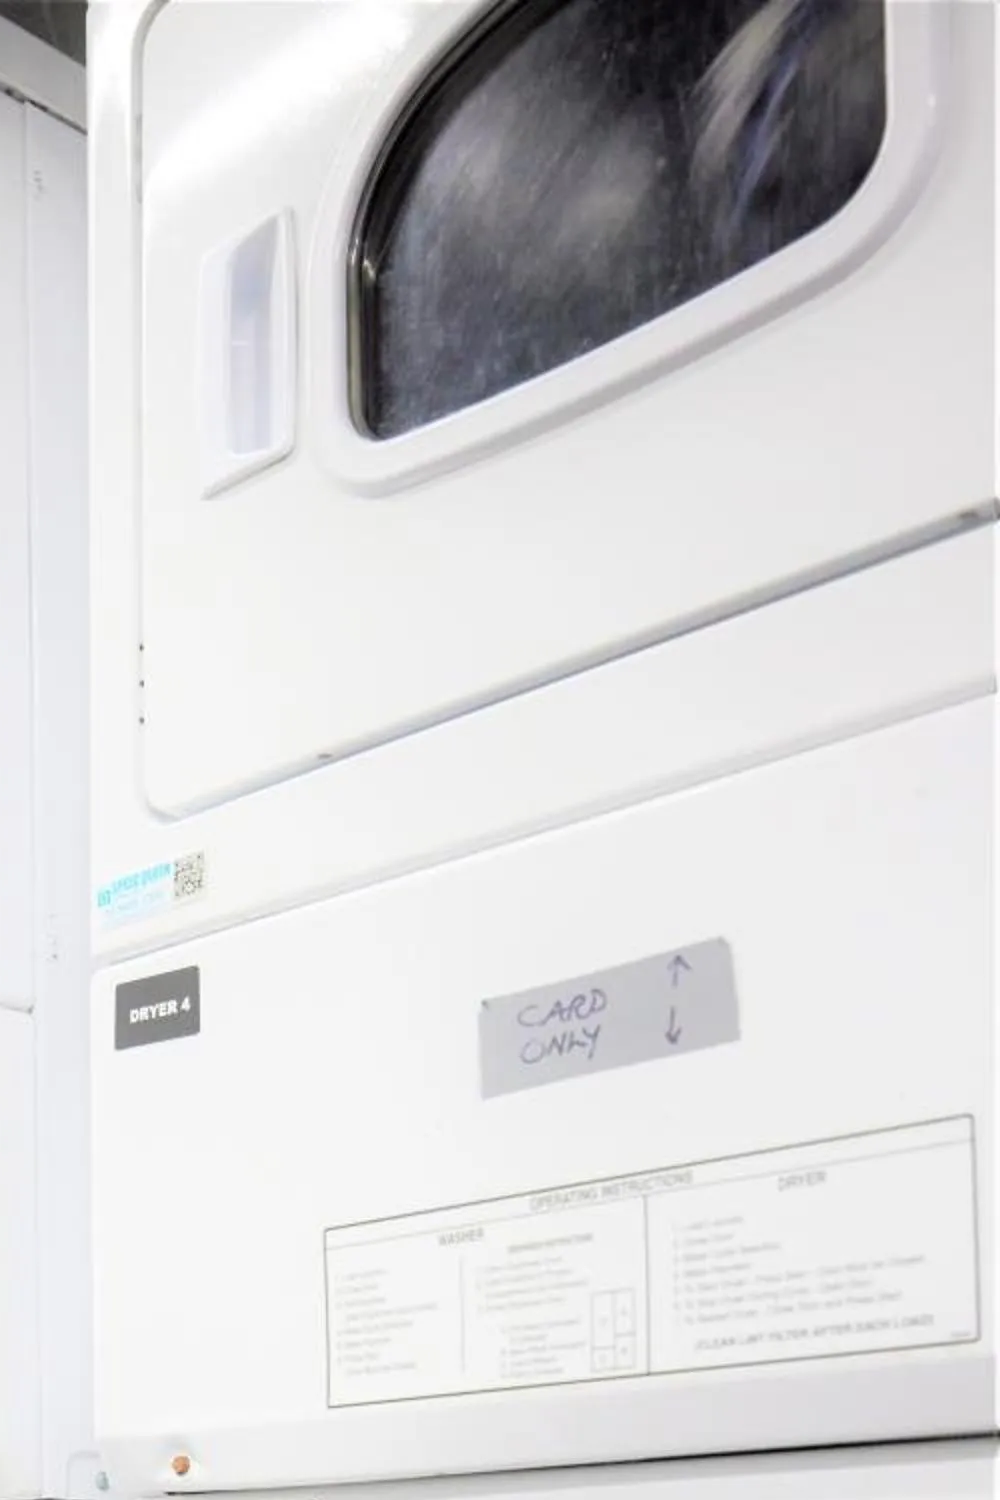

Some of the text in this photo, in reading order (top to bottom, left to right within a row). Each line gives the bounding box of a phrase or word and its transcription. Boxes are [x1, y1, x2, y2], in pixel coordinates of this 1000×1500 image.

[129, 996, 192, 1024] DRYER 4
[517, 988, 608, 1027] CARD
[520, 1024, 601, 1065] ONLY
[529, 1169, 694, 1212] OPERATING INSTRUCTIONS
[776, 1170, 828, 1192] DRYER
[437, 1227, 485, 1248] WASHER
